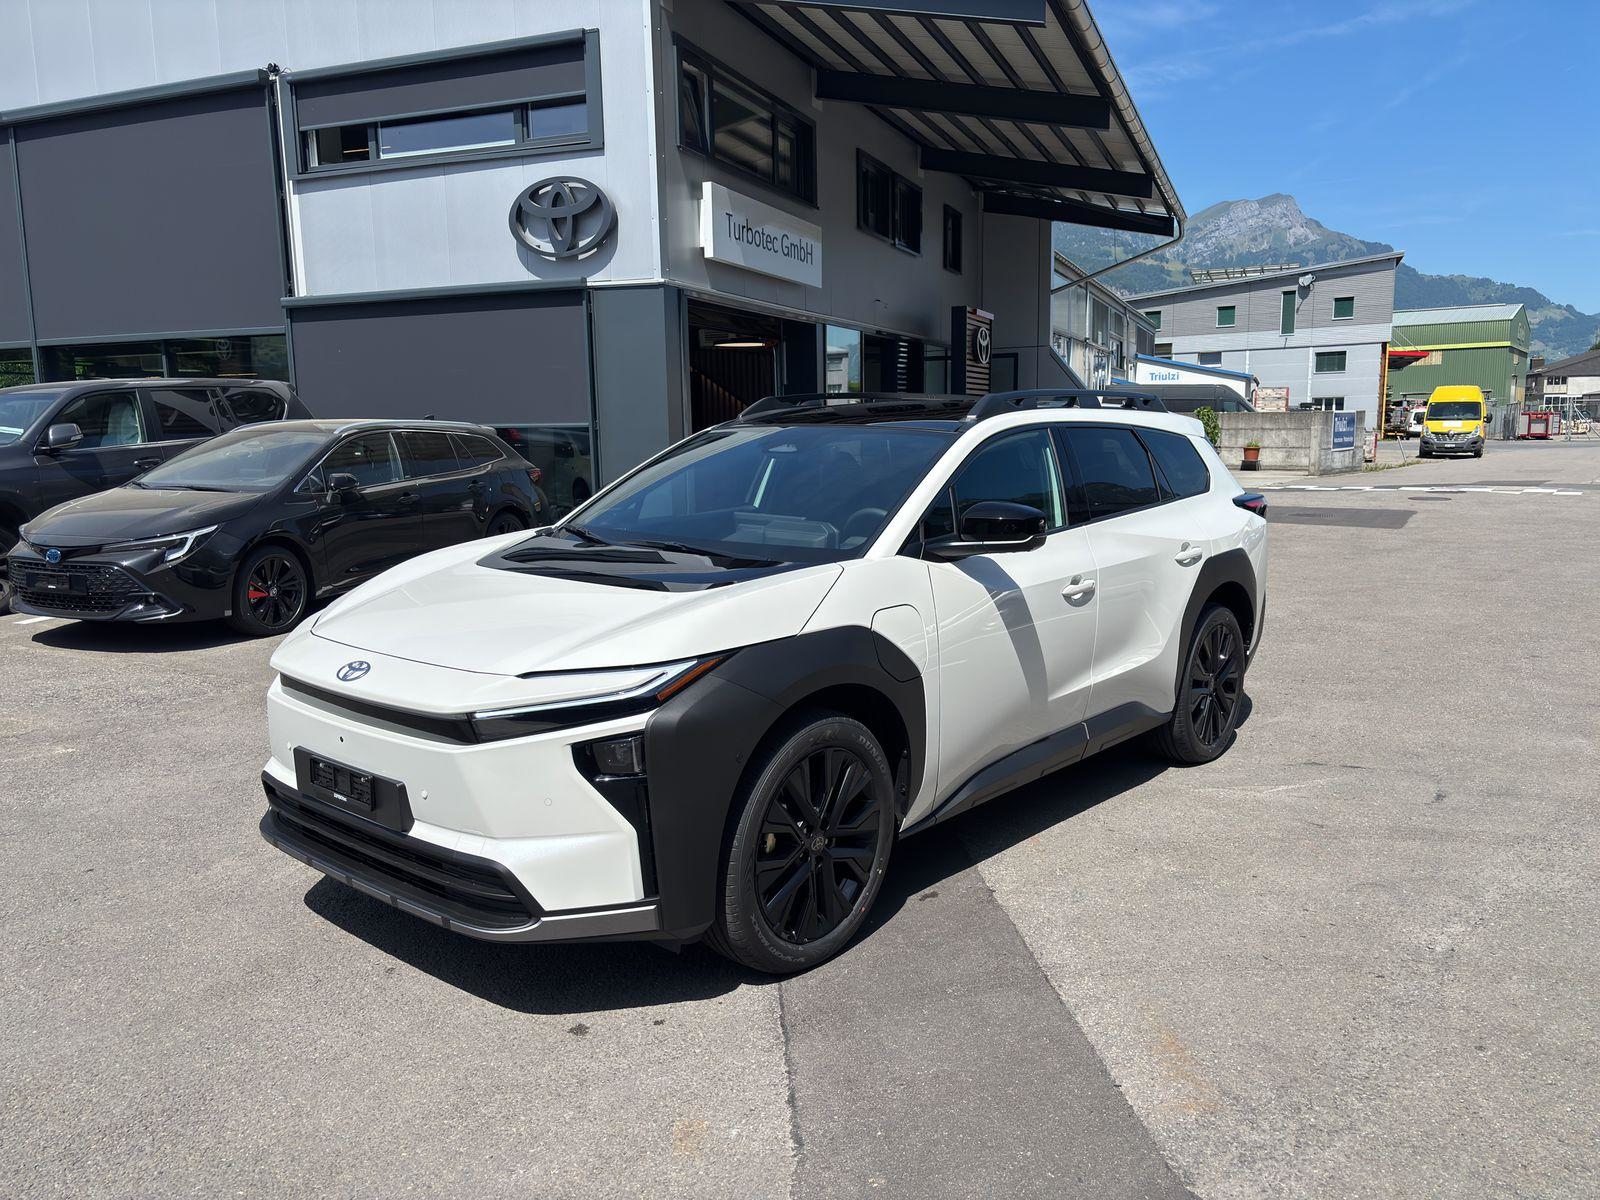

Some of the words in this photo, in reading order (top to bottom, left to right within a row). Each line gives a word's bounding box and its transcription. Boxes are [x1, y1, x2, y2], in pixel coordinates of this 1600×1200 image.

[725, 212, 779, 254] Turbotec
[780, 233, 814, 266] GmbH
[1149, 372, 1180, 381] Triulzi
